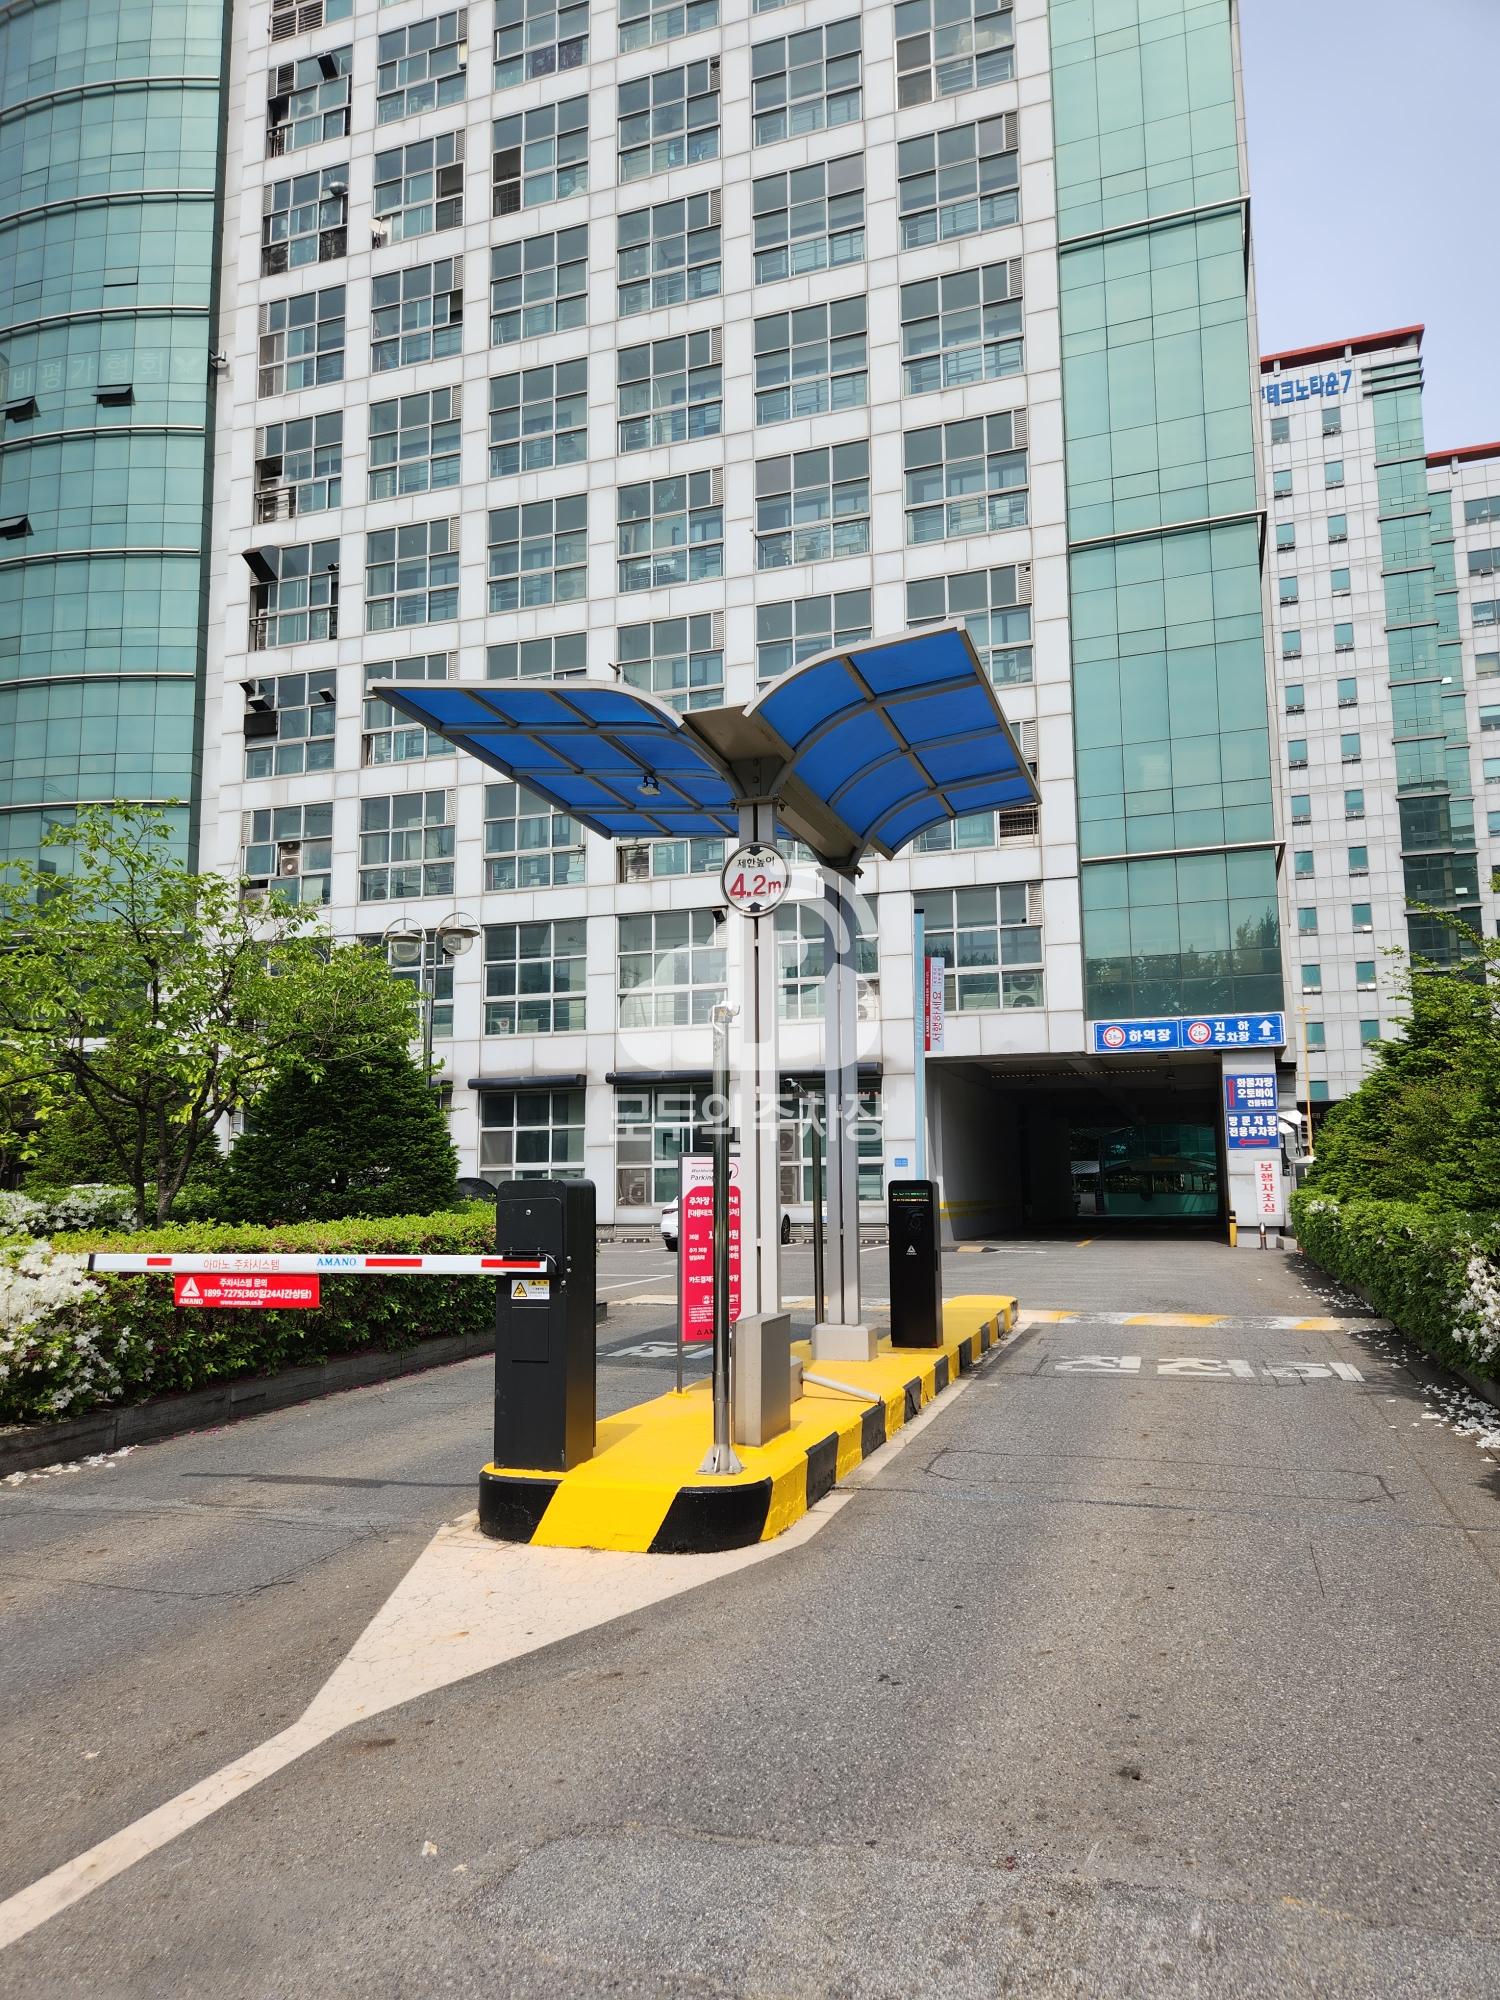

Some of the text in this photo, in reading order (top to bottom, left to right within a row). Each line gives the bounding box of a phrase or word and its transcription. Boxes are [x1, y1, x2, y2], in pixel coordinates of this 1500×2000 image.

[1261, 368, 1352, 407] 테크노타운7
[737, 856, 775, 868] 제한높이
[730, 872, 781, 898] 4.2m
[932, 991, 943, 1043] 서행하세요
[1128, 1028, 1171, 1042] 하역장
[1214, 1032, 1250, 1043] 주차장
[1237, 1088, 1274, 1099] 오토바이
[1229, 1126, 1278, 1137] 전용주차장
[688, 1196, 710, 1206] 주차장
[203, 1259, 280, 1271] 아마노 주차시스템
[317, 1257, 357, 1266] AMANO
[219, 1278, 268, 1288] 주차시스템 문의
